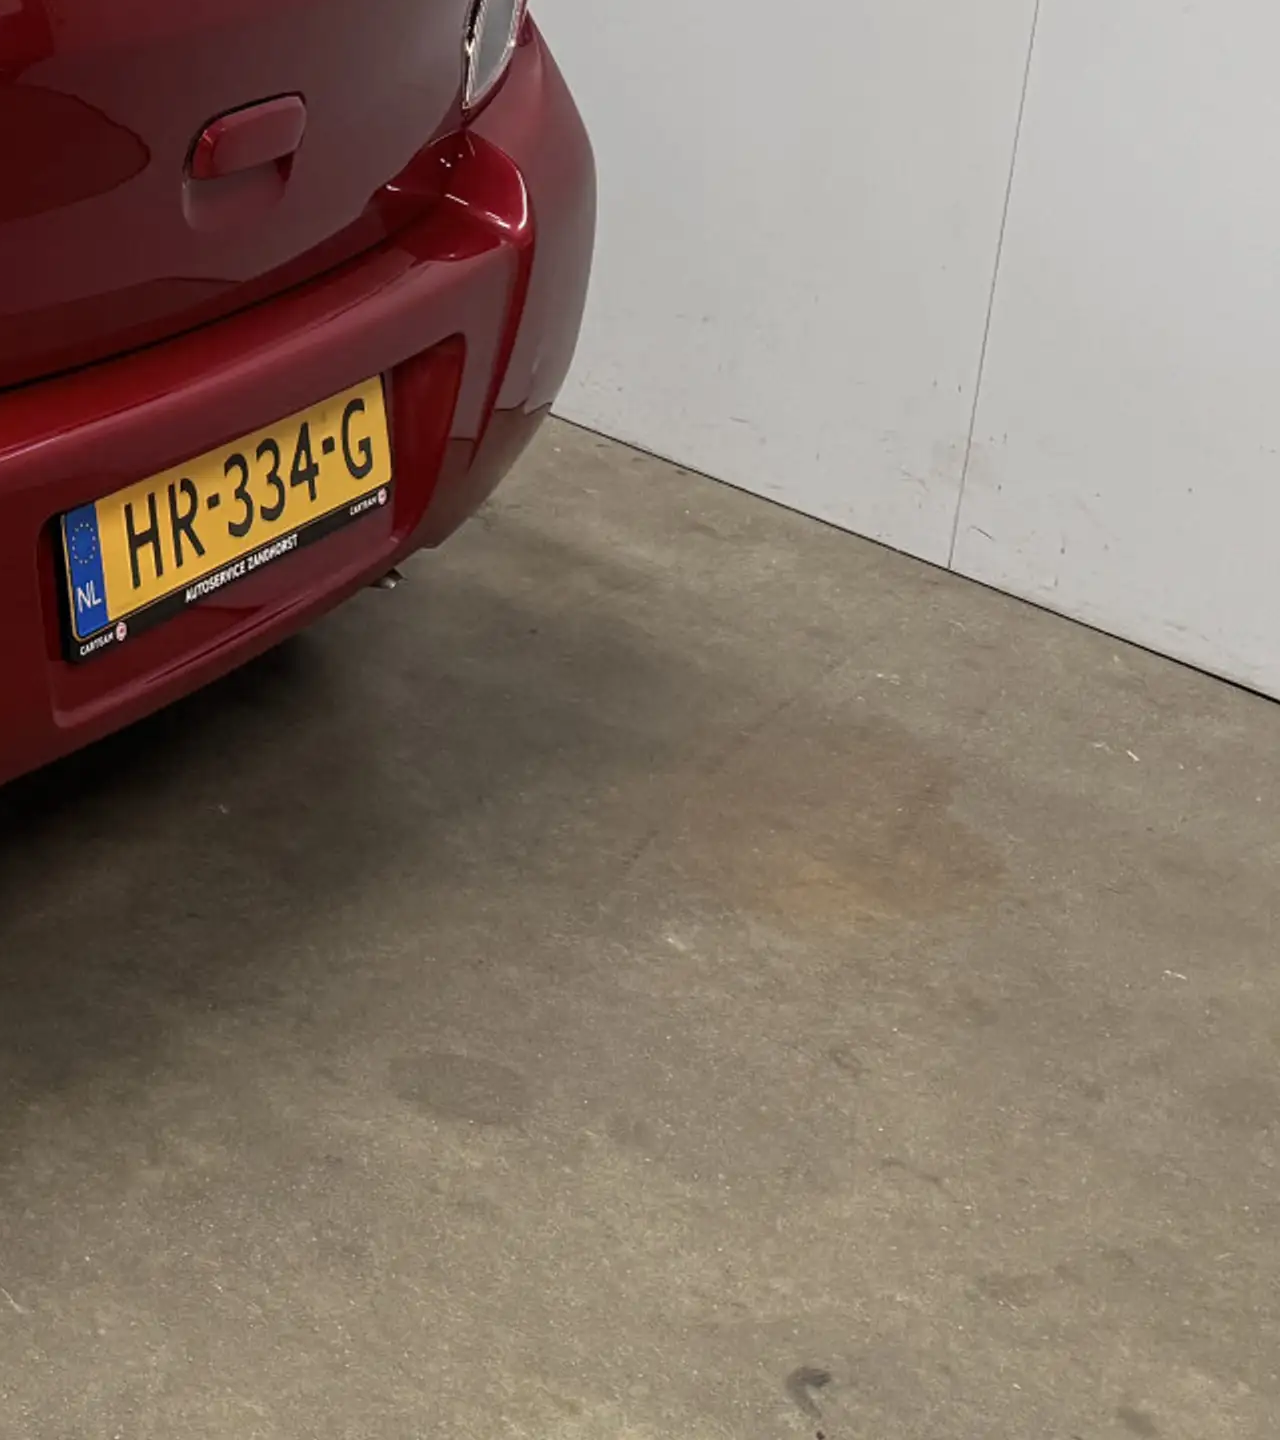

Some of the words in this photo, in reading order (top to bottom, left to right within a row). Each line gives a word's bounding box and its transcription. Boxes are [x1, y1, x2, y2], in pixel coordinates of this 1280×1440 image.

[123, 398, 374, 589] HR-334-G
[77, 579, 102, 613] NL
[184, 560, 246, 603] AUTOSERVICE
[246, 533, 298, 570] ZANDHORST
